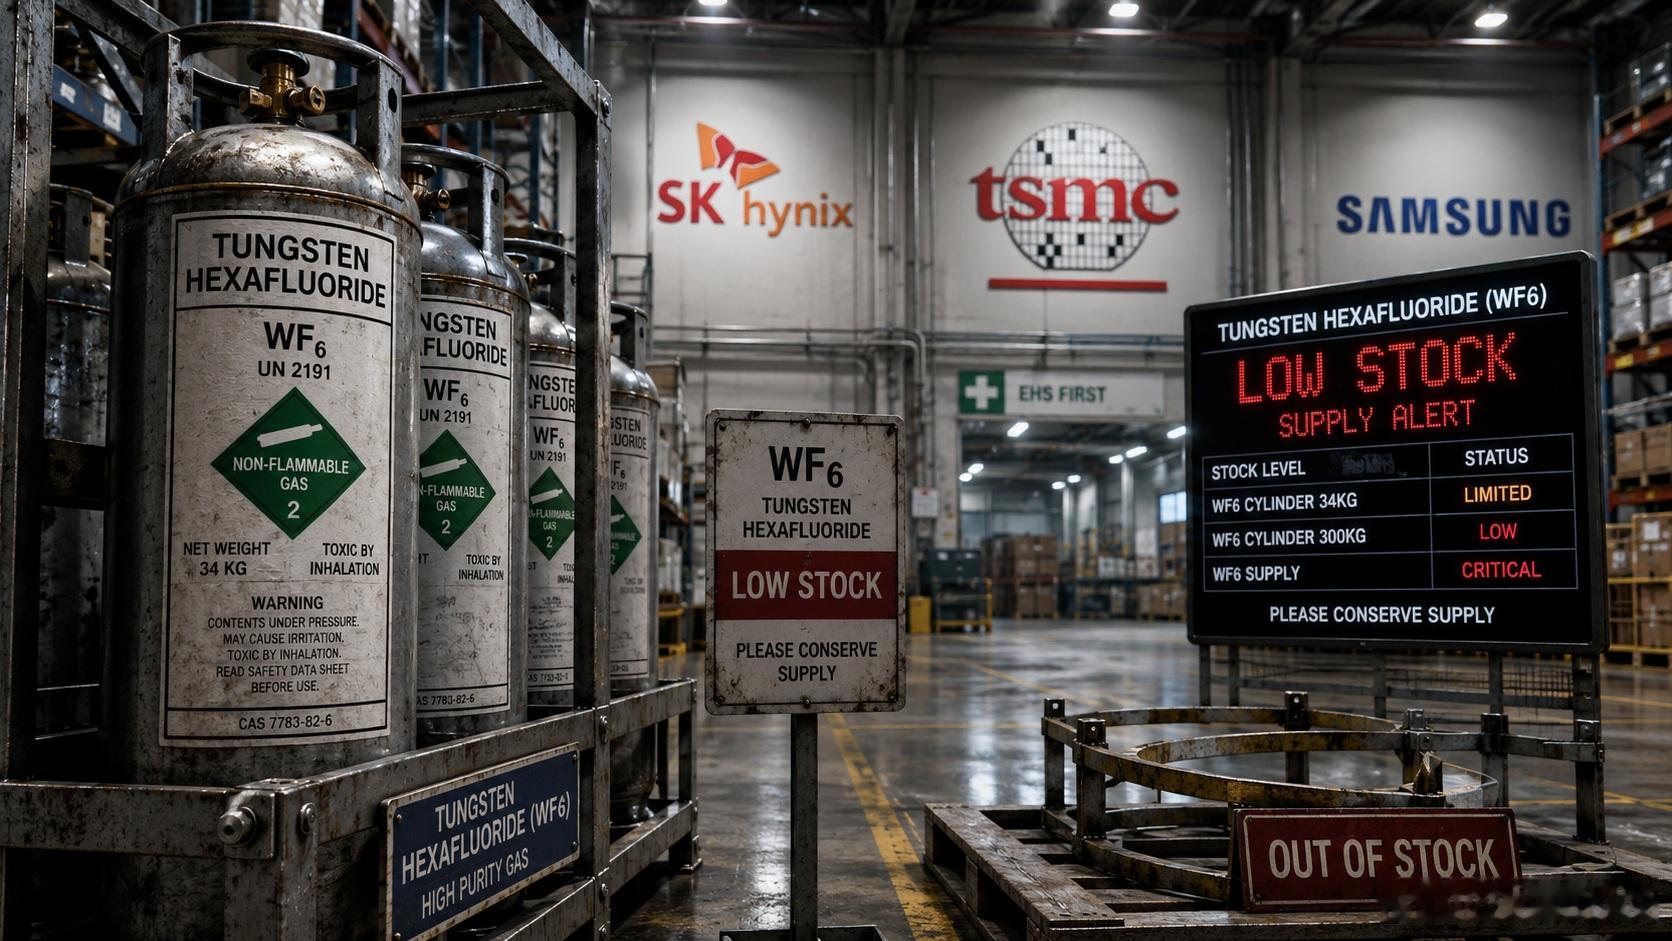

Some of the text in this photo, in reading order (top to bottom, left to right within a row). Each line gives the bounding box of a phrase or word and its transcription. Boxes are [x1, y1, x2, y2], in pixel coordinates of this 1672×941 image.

[969, 166, 1180, 225] tsmc
[657, 180, 854, 238] SK hynix
[1336, 194, 1572, 238] SAMSUNG
[212, 233, 369, 272] TUNGSTEN
[186, 266, 386, 308] HEXAFLUORIDE
[1217, 282, 1547, 343] TUNGSTEN HEXAFLUORIDE (WF6)
[420, 311, 496, 340] NGSTEN
[420, 337, 507, 367] FLUORIDE
[258, 360, 330, 380] UN 2191
[1238, 331, 1517, 404] LOW STOCK
[529, 374, 575, 394] NGSTE
[1019, 385, 1107, 403] EHS FIRST
[420, 408, 472, 424] UN 2191
[1279, 399, 1476, 438] SUPPLY ALERT
[233, 456, 349, 474] NON-FLAMMABLE
[530, 450, 567, 462] UN 2191
[1464, 447, 1529, 467] STATUS
[1211, 460, 1306, 480] STOCK LEVEL
[280, 476, 308, 491] GAS
[420, 484, 485, 498] N-FLAMMABLE
[1212, 491, 1358, 513] WF6 CYLINDER 34KG
[1464, 485, 1532, 503] LIMITED
[287, 501, 300, 519] 2
[436, 500, 457, 512] GAS
[762, 497, 852, 515] TUNGSTEN
[441, 519, 451, 534] 2
[743, 521, 871, 539] HEXAFLUORIDE
[1479, 523, 1517, 540] LOW
[546, 536, 553, 548] 2
[1212, 527, 1367, 548] WF6 CYLINDER 300KG
[183, 541, 271, 556] NET WEIGHT
[323, 542, 375, 557] TOXIC BY
[200, 561, 247, 576] 34 KG
[310, 561, 380, 576] INHALATION
[466, 554, 501, 566] TOXIC BY
[458, 569, 504, 581] INHALATION
[1213, 565, 1300, 582] WF6 SUPPLY
[1462, 561, 1542, 579] CRITICAL
[731, 570, 882, 600] LOW STOCK
[252, 596, 324, 610] WARNING
[207, 616, 360, 629] CONTENTS UNDER PRESSURE.
[1269, 606, 1495, 624] PLEASE CONSERVE SUPPLY
[223, 632, 344, 645] MAY CAUSE IRRITATION.
[228, 648, 342, 661] TOXIC BY INHALATION.
[736, 641, 878, 659] PLEASE CONSERVE
[216, 663, 350, 677] READ SAFETY DATA SHEET
[777, 665, 837, 681] SUPPLY
[251, 680, 319, 693] BEFORE USE.
[416, 695, 429, 705] AS
[238, 714, 333, 730] CAS 7783-82-6
[434, 780, 515, 833] TUNGSTEN
[402, 791, 571, 885] HEXAFLUORIDE (WF6)
[1268, 838, 1500, 881] OUT OF STOCK
[421, 847, 529, 919] HIGH PURITY GAS
